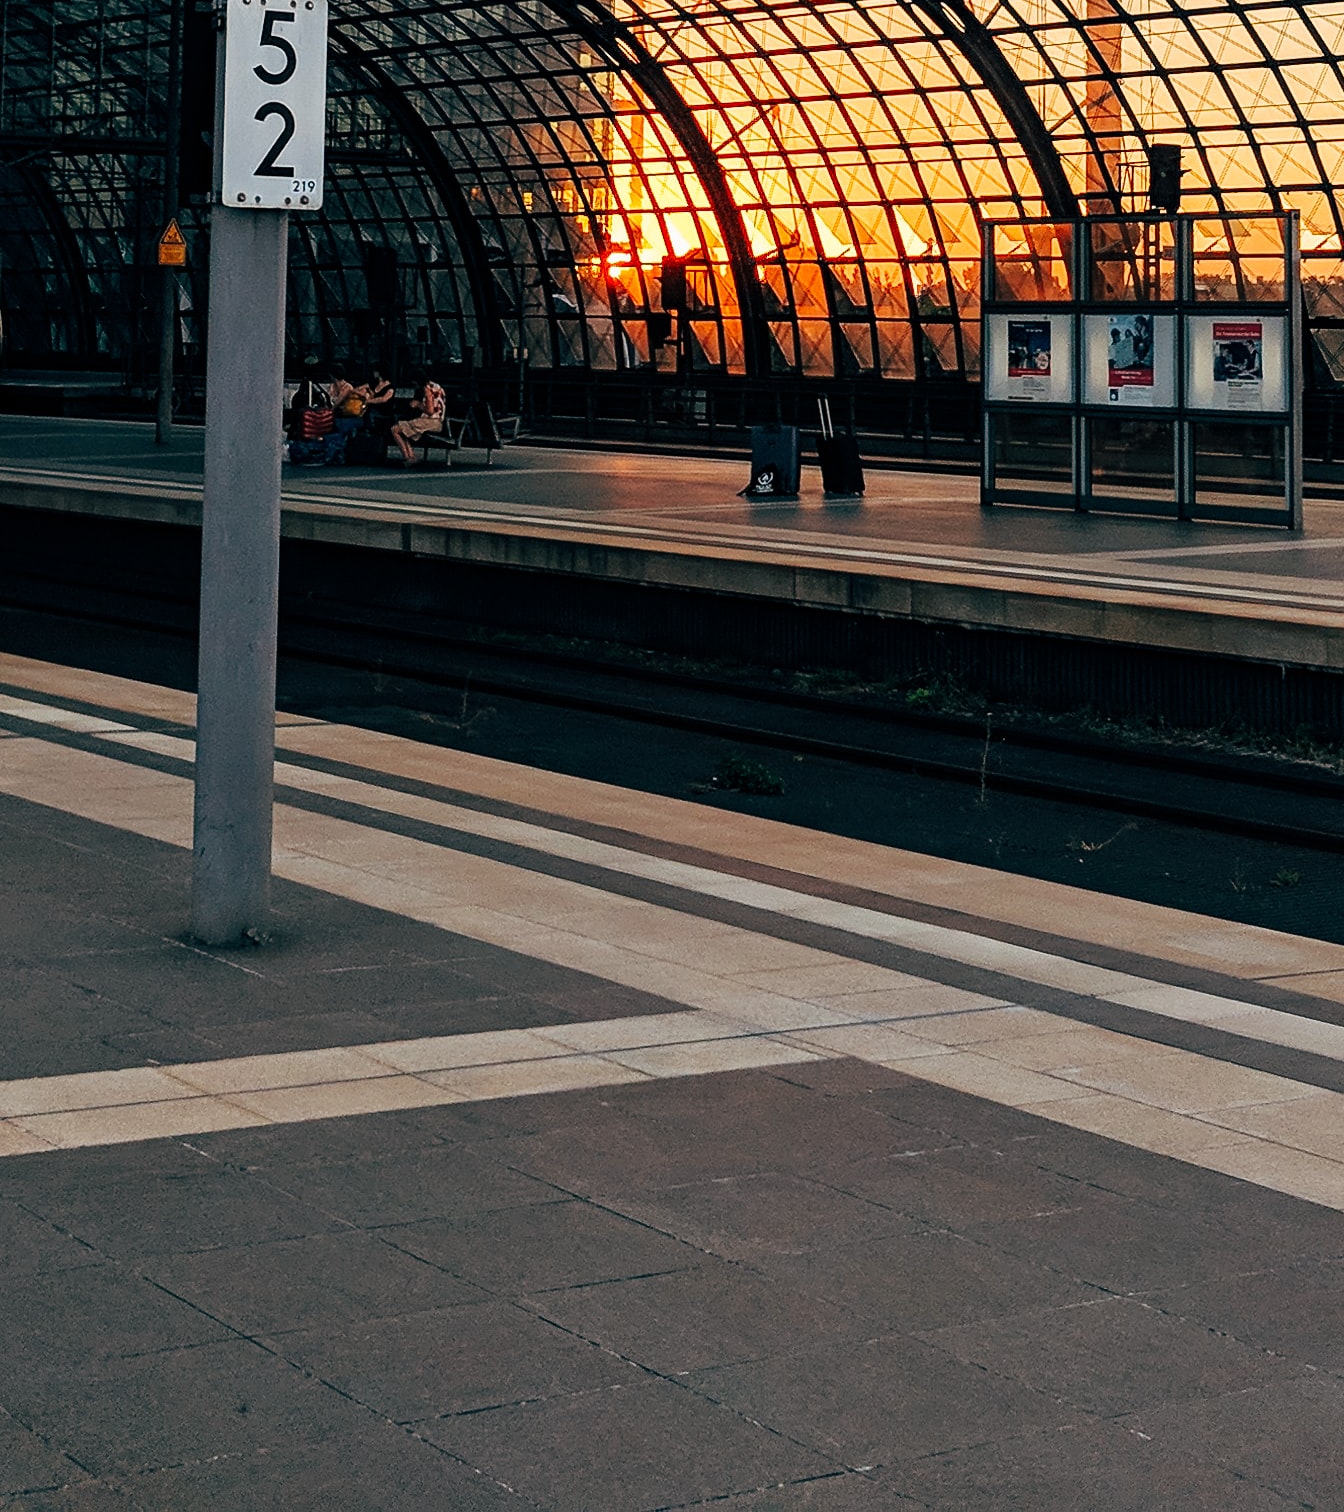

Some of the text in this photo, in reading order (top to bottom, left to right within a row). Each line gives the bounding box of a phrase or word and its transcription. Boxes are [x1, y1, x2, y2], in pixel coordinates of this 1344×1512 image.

[253, 10, 297, 86] 5
[253, 101, 296, 178] 2
[292, 180, 316, 194] 219
